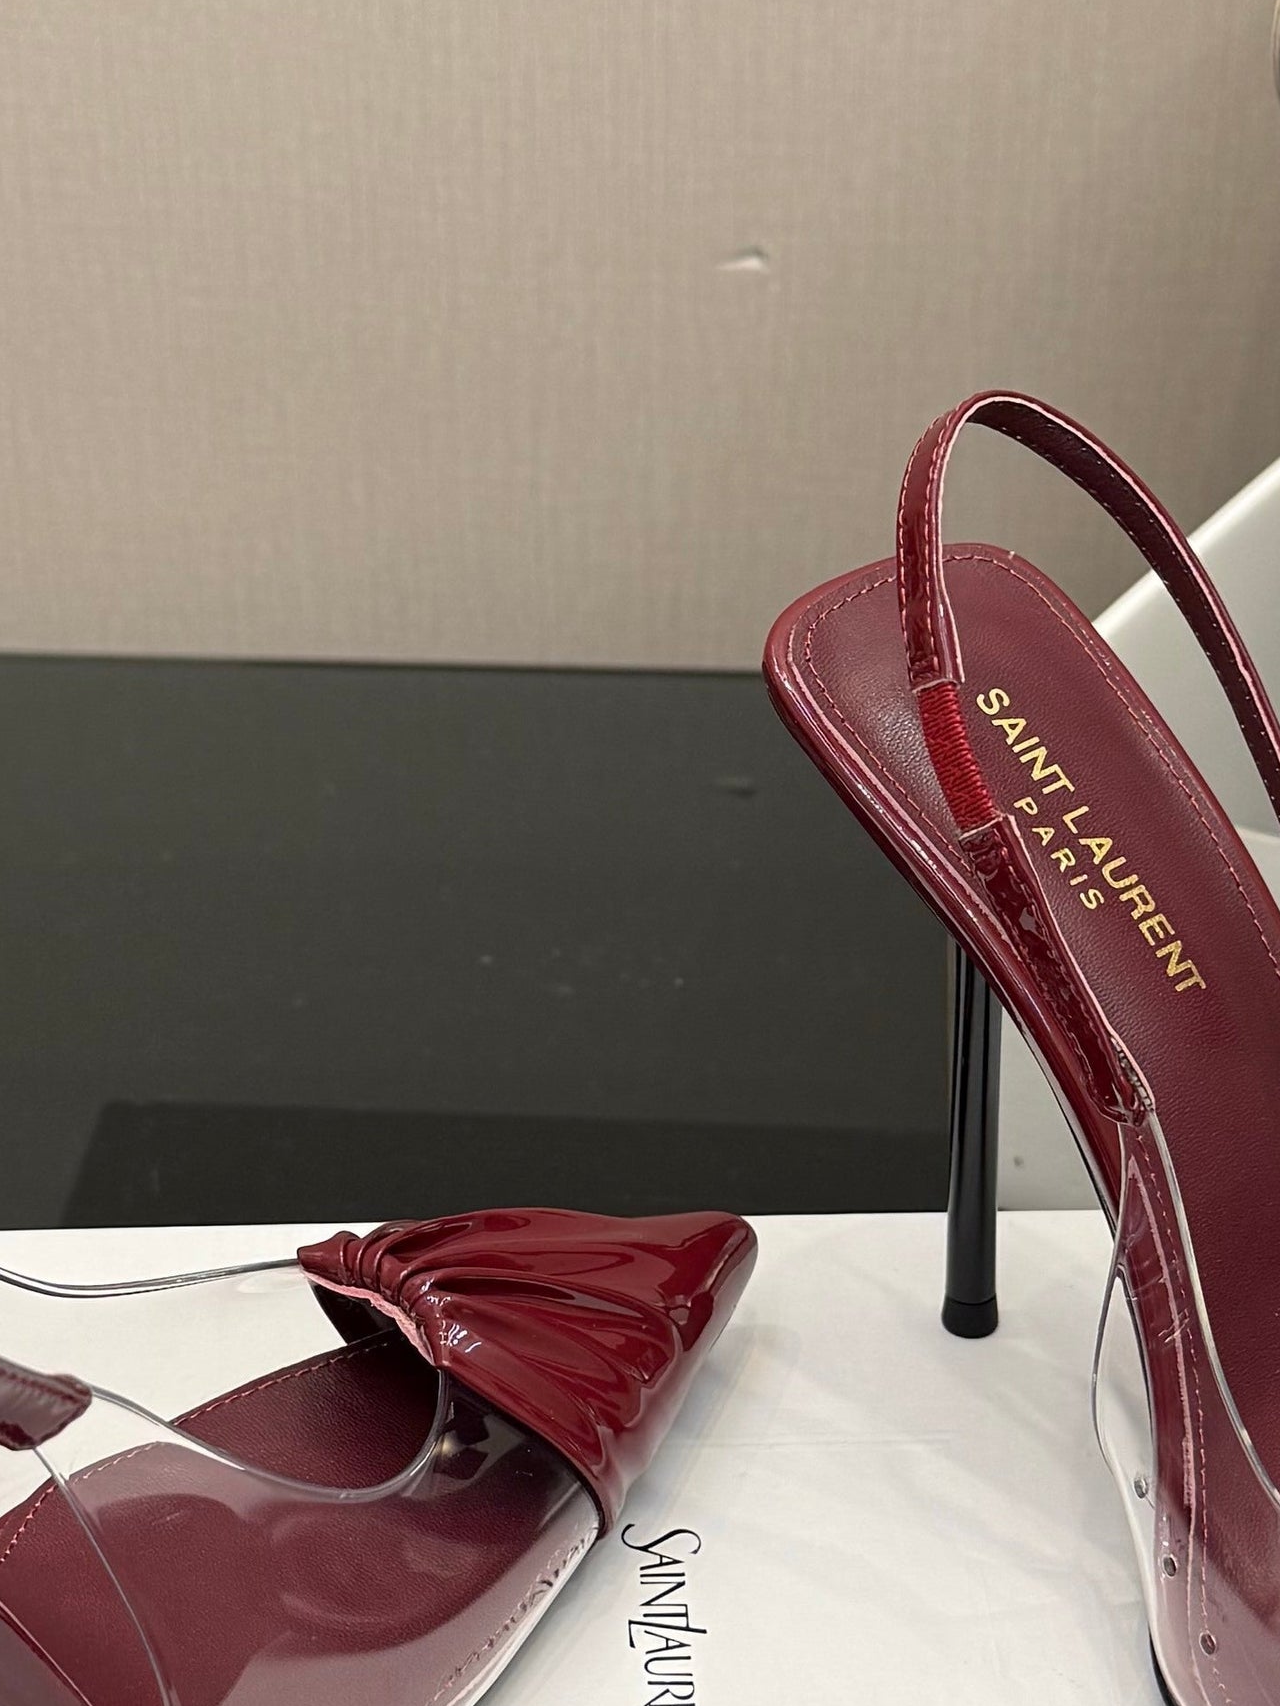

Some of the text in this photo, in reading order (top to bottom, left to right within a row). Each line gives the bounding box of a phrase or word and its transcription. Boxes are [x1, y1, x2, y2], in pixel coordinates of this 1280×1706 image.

[976, 687, 1207, 993] SAINT LAURENT
[1013, 796, 1105, 910] PARIS
